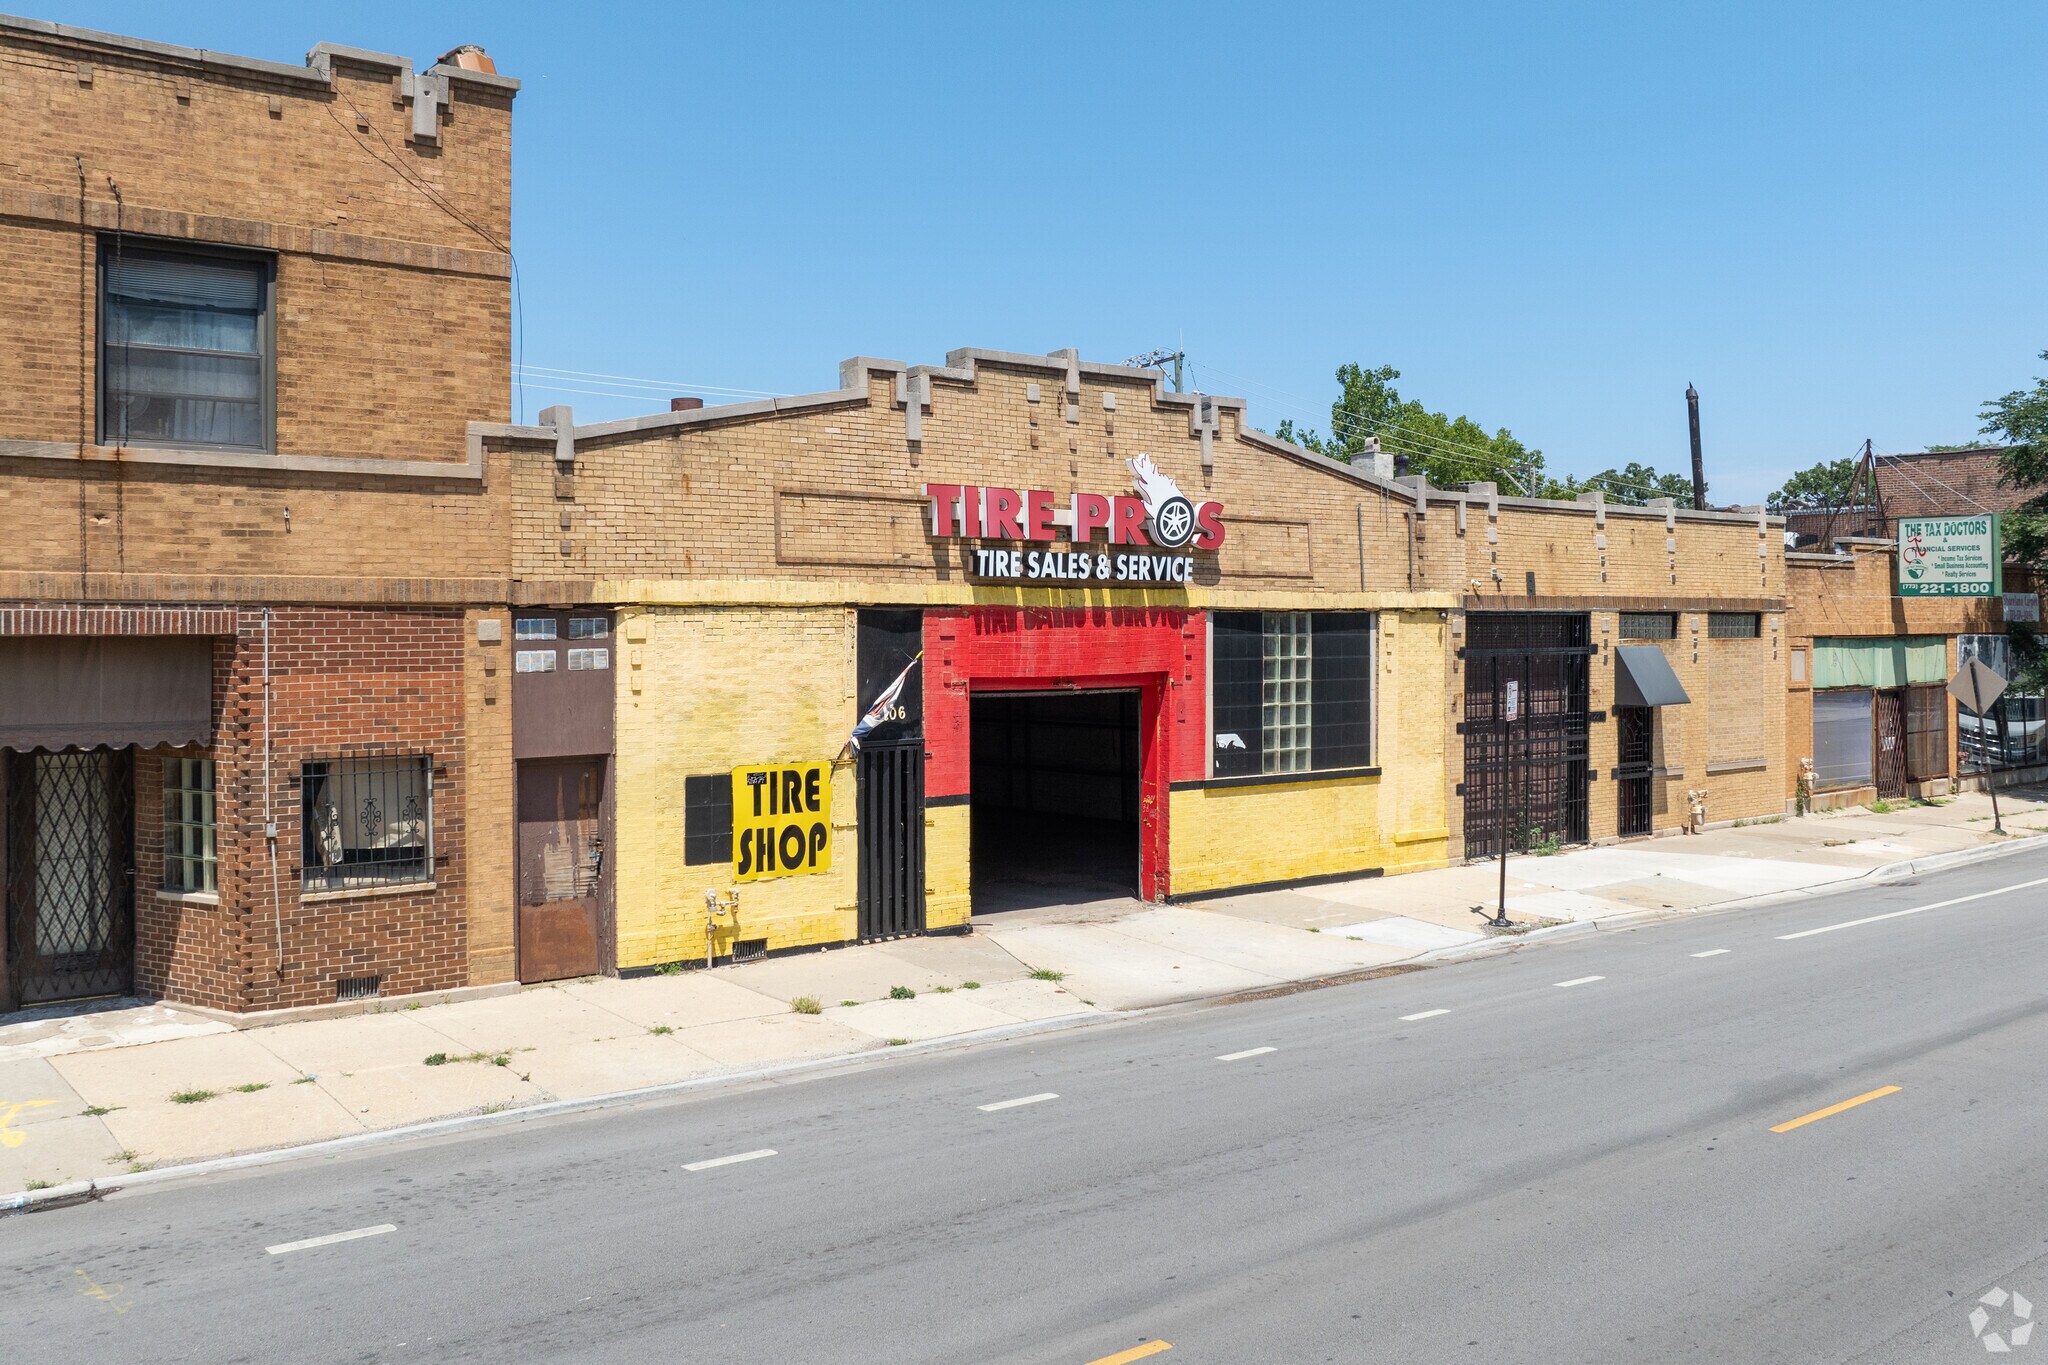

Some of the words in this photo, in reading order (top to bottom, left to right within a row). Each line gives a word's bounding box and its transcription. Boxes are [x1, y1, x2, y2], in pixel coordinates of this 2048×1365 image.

[921, 483, 1056, 541] TIRE
[1905, 523, 1922, 537] THE
[1925, 522, 1941, 536] TAX
[1944, 520, 1987, 536] DOCTORS
[976, 550, 1021, 577] TIRE
[1028, 552, 1090, 580] SALES
[1096, 553, 1110, 580] &
[1116, 554, 1194, 582] SERVICE
[1920, 583, 1989, 594] 221-1800
[885, 705, 906, 721] 06
[747, 769, 820, 817] TIRE
[738, 822, 828, 875] SHOP
